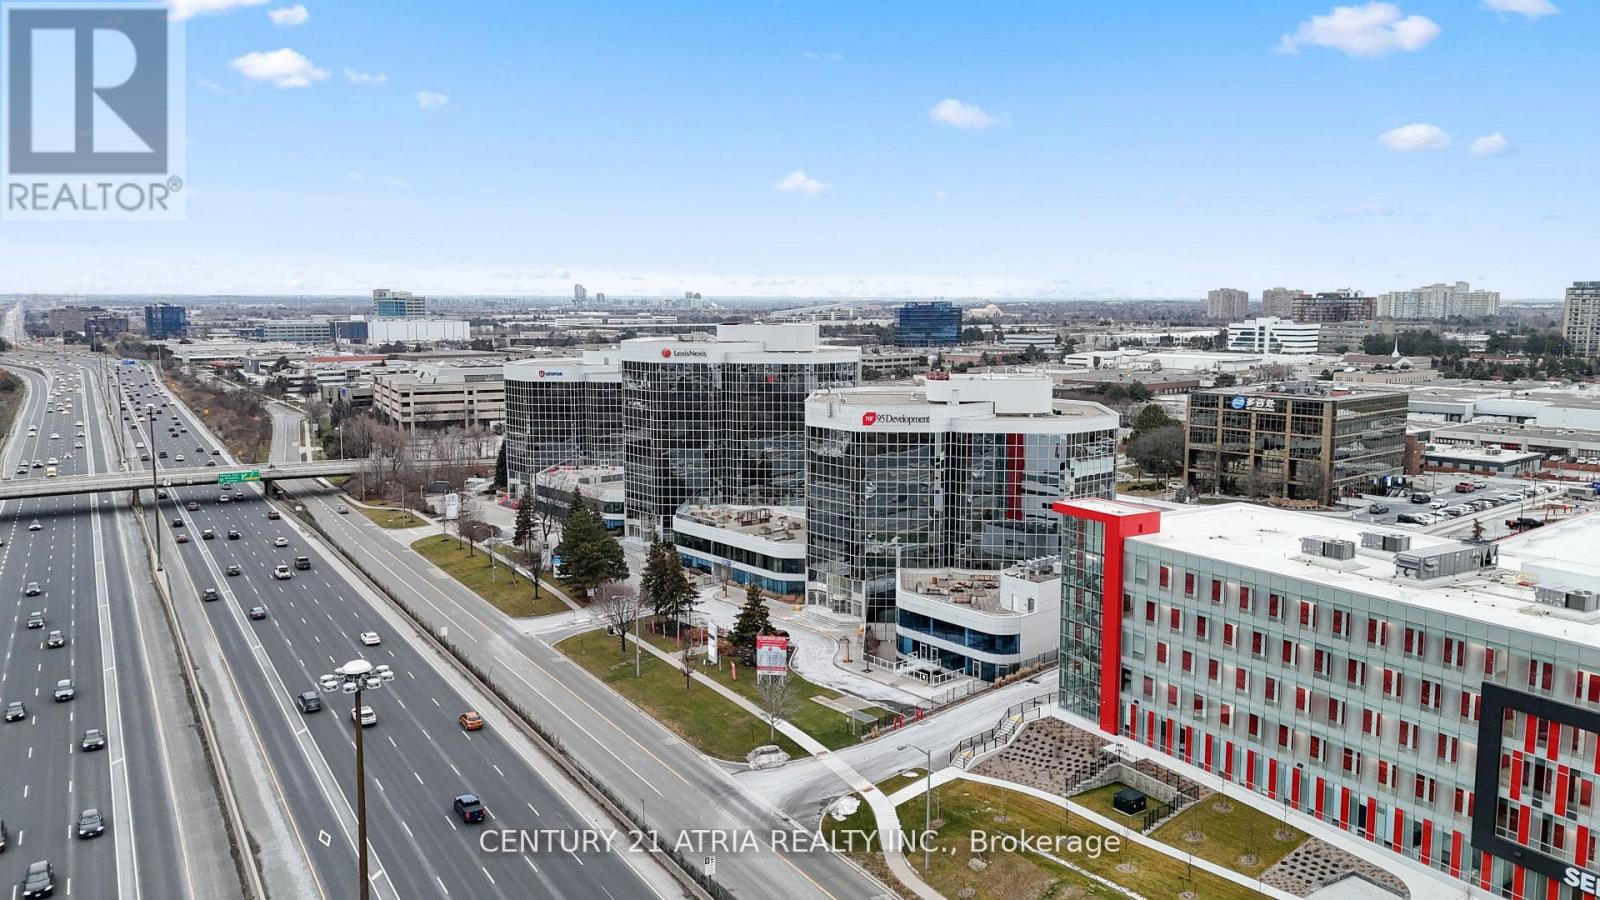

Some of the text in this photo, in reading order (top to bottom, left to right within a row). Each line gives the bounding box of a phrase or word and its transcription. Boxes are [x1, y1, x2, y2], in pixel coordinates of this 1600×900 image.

[673, 349, 707, 357] LexisNexis
[877, 414, 885, 423] 95
[886, 414, 930, 425] Development
[1563, 867, 1600, 897] SE
